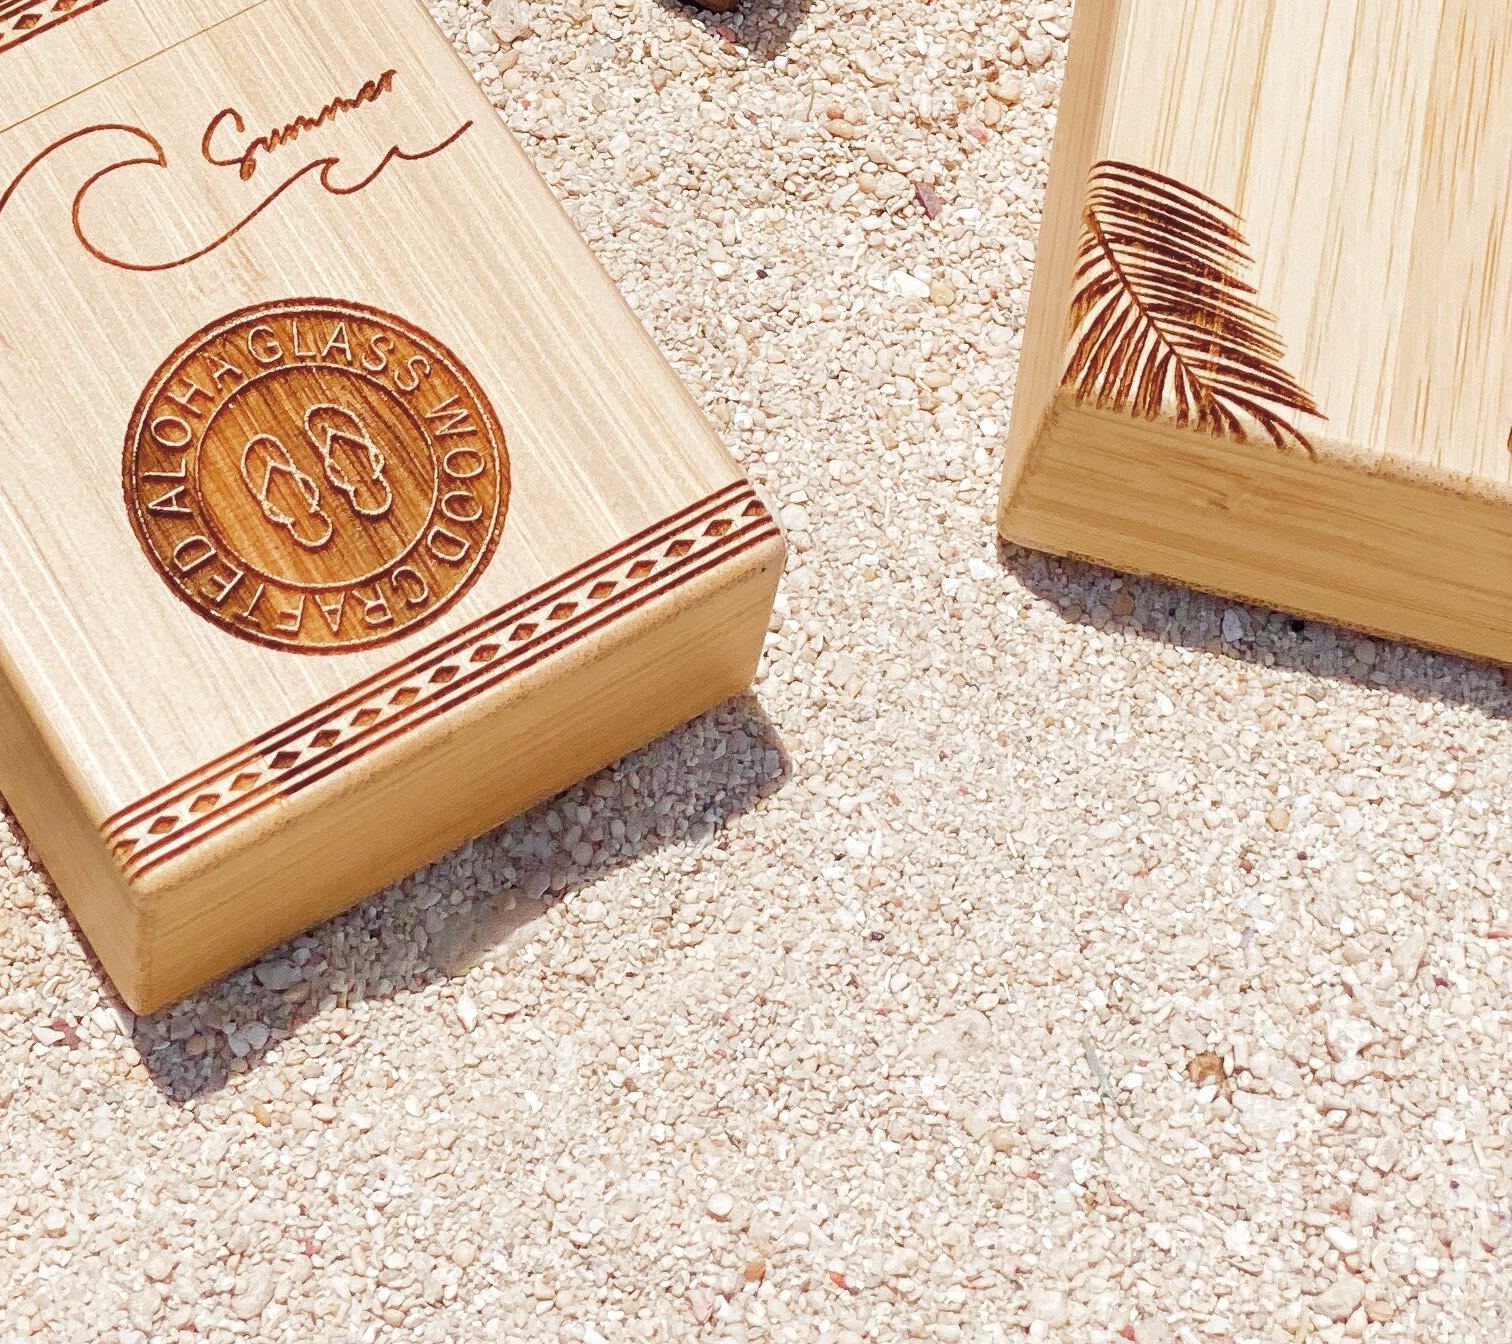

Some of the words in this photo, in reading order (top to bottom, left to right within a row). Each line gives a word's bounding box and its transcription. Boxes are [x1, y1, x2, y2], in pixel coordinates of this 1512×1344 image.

[248, 321, 432, 392] GLASS
[144, 352, 249, 513] ALOHA
[426, 396, 486, 562] WOOD
[171, 534, 429, 633] CRAFTED
